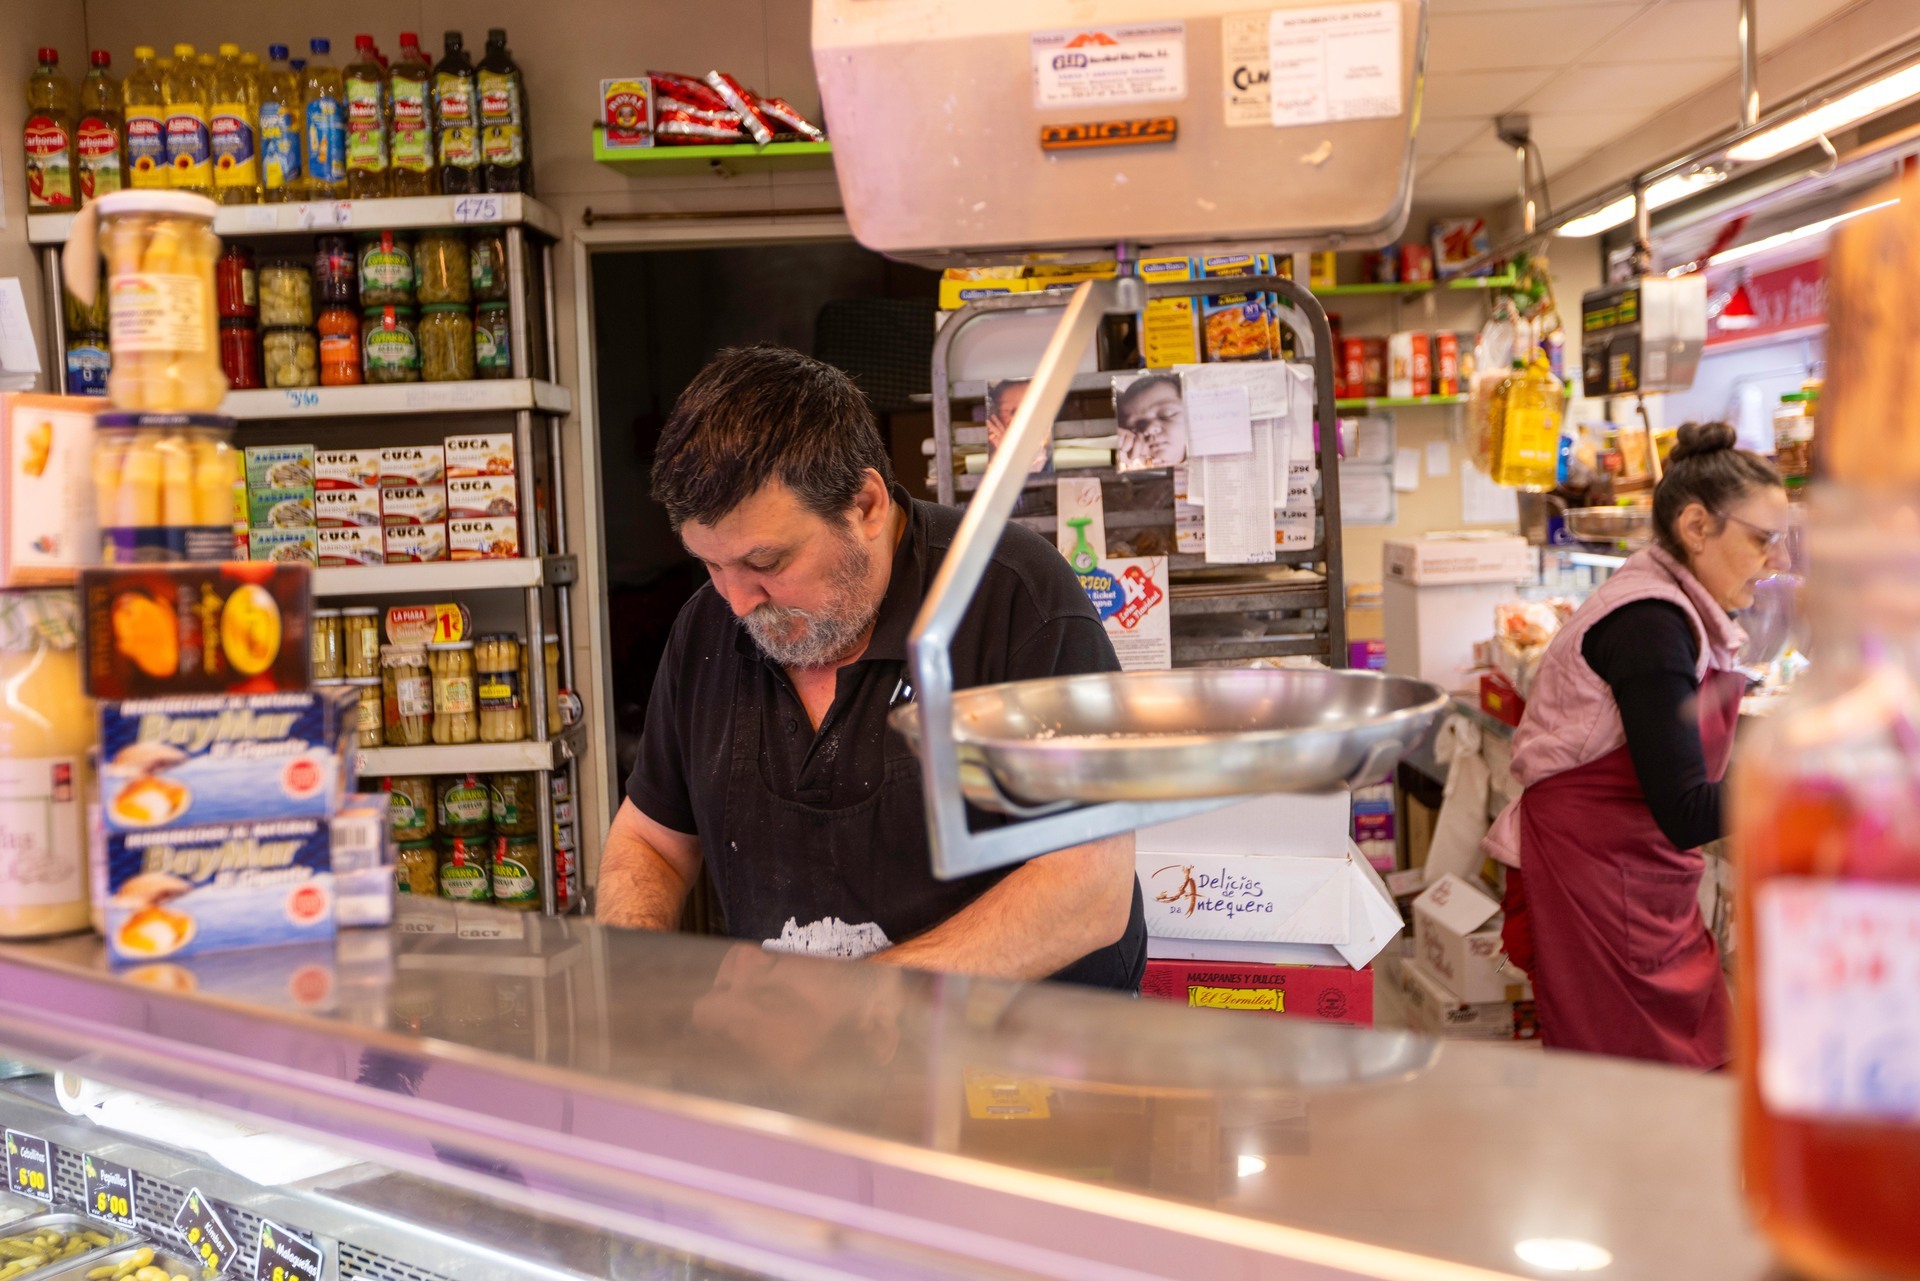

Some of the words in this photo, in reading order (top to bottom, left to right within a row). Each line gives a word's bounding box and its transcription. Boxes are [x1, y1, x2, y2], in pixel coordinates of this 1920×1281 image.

[448, 438, 489, 449] CUCA
[317, 453, 358, 464] CUCA
[382, 451, 422, 461] CUCA
[450, 481, 491, 492] CUCA
[317, 493, 357, 503] CUCA
[385, 488, 424, 499] CUCA
[387, 527, 425, 538] CUCA
[452, 522, 493, 533] CUCA
[320, 531, 360, 541] CUCA
[393, 611, 402, 622] LA
[403, 610, 425, 621] PIARA
[1198, 867, 1263, 897] Delicias
[1221, 889, 1235, 898] de
[1187, 972, 1241, 983] MAZAPANES
[1243, 974, 1251, 984] Y
[1252, 974, 1286, 985] DULCES
[1200, 991, 1215, 1004] El
[1218, 992, 1274, 1006] Dormilón
